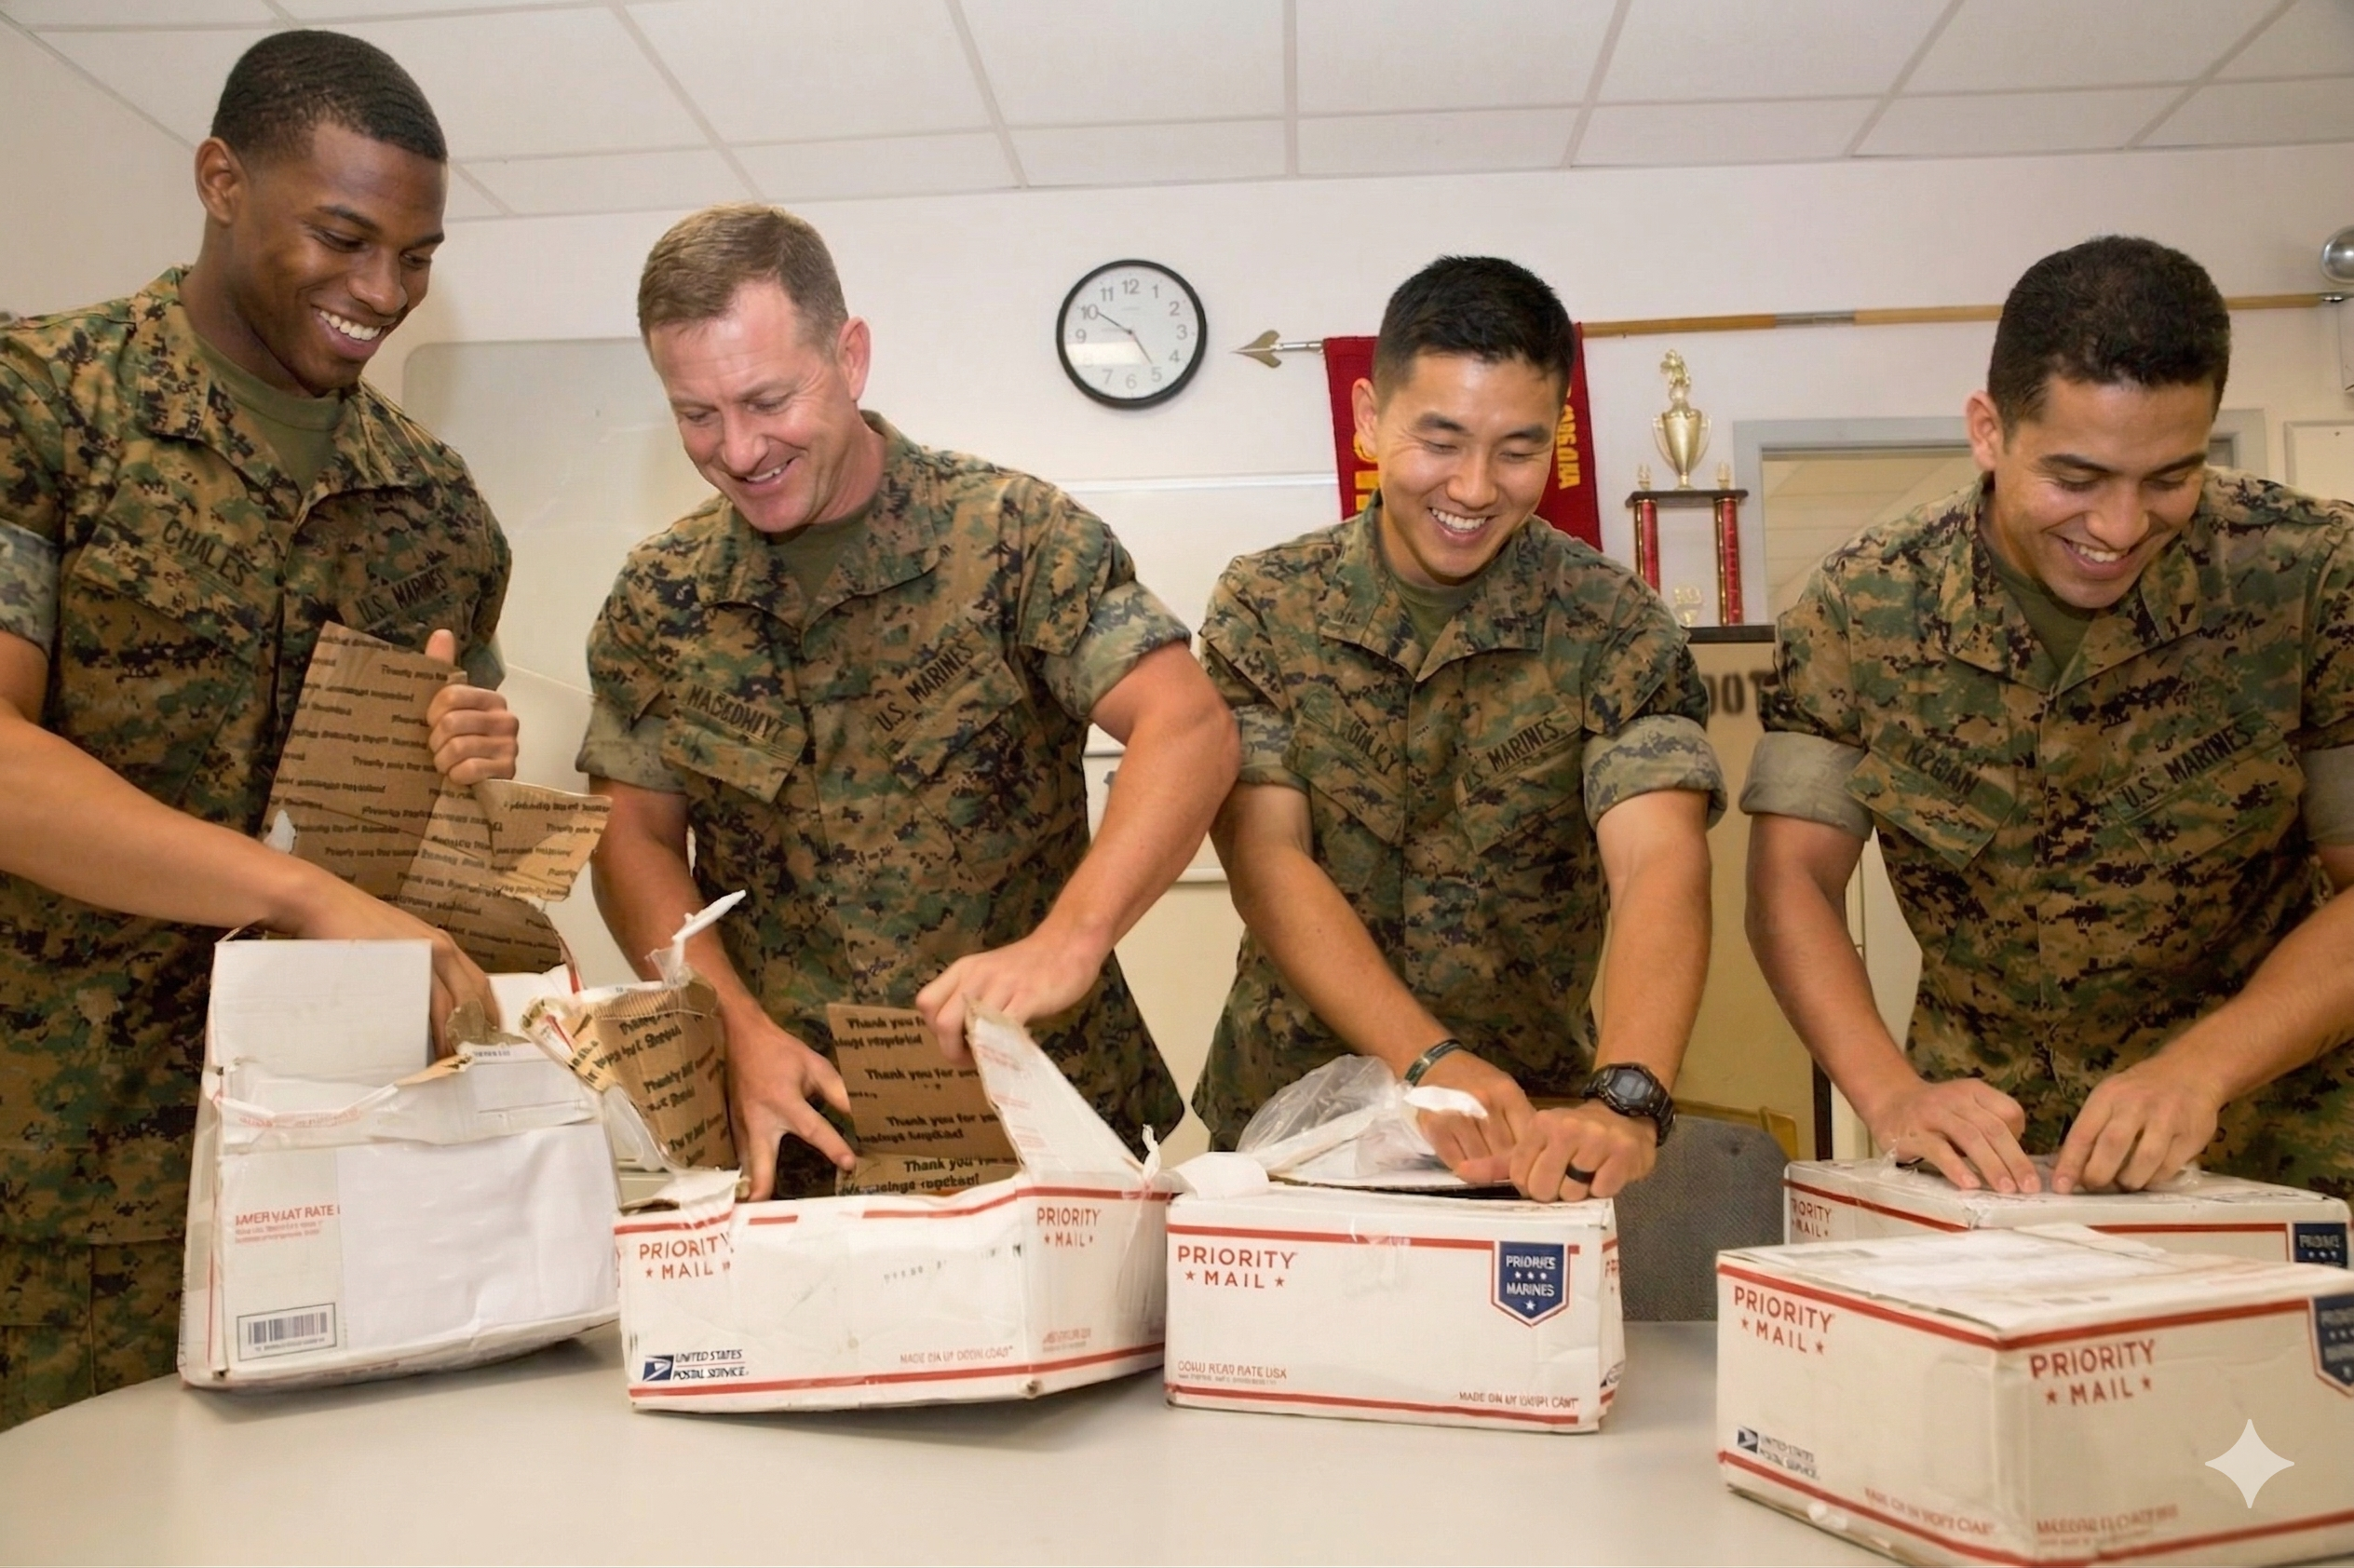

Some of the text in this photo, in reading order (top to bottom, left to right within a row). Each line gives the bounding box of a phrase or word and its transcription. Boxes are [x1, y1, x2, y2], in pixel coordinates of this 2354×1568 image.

[1101, 287, 1115, 303] 11
[1122, 278, 1140, 295] 12
[1153, 284, 1160, 299] 1
[1081, 304, 1100, 321] 10
[1169, 301, 1180, 317] 2
[1075, 328, 1087, 344] 9
[1177, 324, 1188, 340] 3
[1169, 349, 1180, 363] 4
[1102, 369, 1114, 385] 7
[1126, 372, 1137, 389] 6
[1151, 366, 1162, 383] 5
[905, 640, 974, 705] MARINES
[1486, 717, 1560, 773] MARINES
[2163, 721, 2253, 785] MARINES
[903, 1159, 945, 1172] Thank
[1036, 1208, 1101, 1226] PRIORITY
[1055, 1232, 1086, 1248] MAIL
[1178, 1245, 1294, 1270] PRIORITY
[662, 1262, 713, 1280] MAIL
[1204, 1270, 1265, 1289] MAIL
[1506, 1281, 1555, 1297] MARINES
[1734, 1285, 1832, 1334] PRIORITY
[1756, 1319, 1807, 1354] MAIL
[2029, 1338, 2154, 1380] PRIORITY
[2070, 1376, 2134, 1406] MAIL
